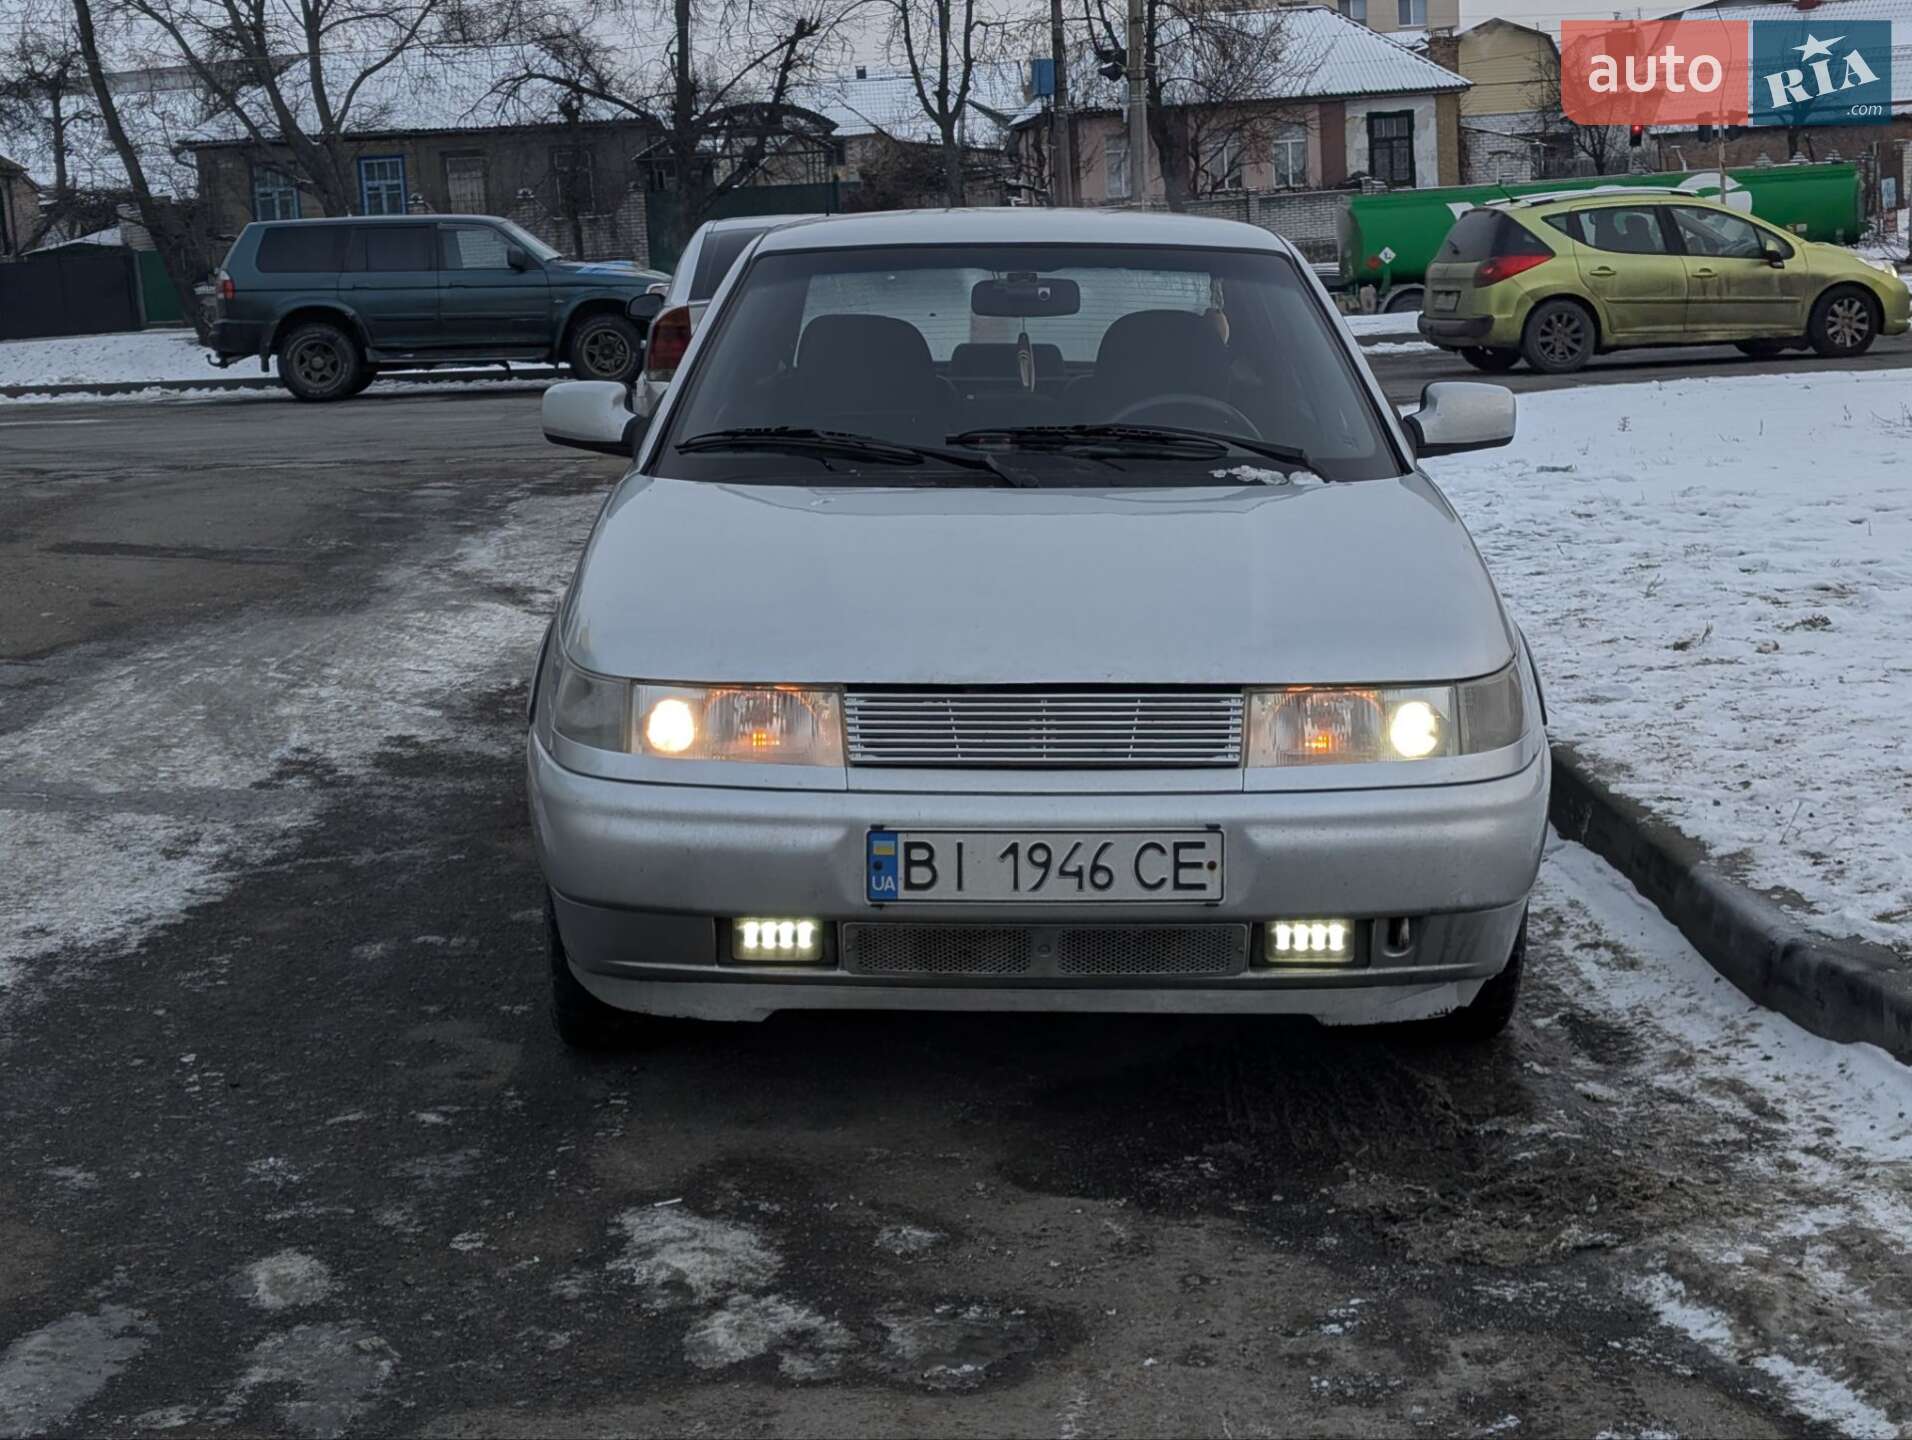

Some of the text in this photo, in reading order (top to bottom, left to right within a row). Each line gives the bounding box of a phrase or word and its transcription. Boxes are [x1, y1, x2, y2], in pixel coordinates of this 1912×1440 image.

[872, 875, 896, 892] UA
[903, 841, 1207, 892] BI 1946 CE
